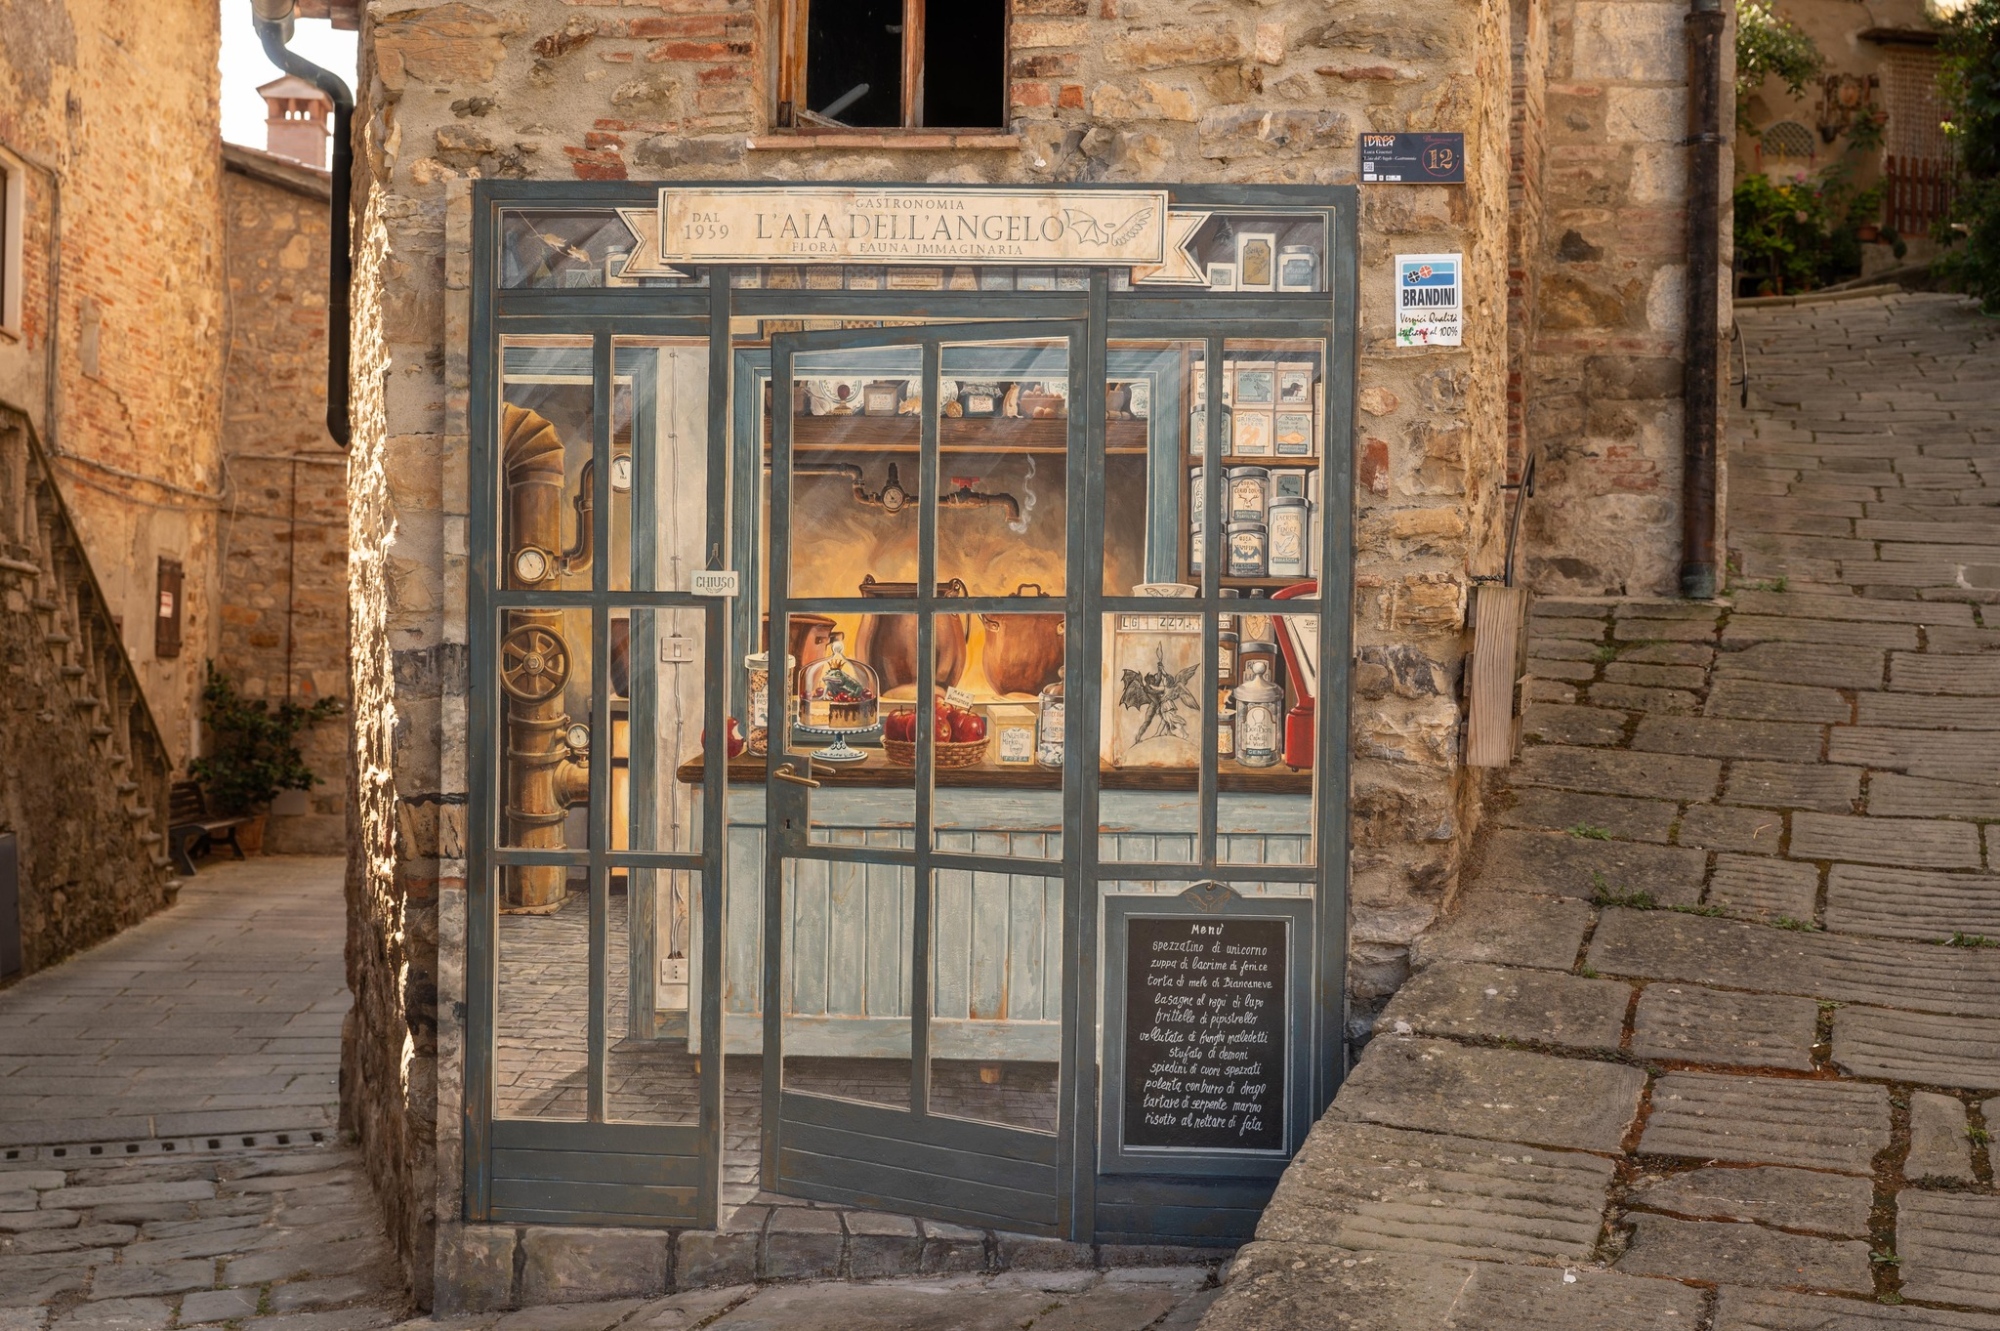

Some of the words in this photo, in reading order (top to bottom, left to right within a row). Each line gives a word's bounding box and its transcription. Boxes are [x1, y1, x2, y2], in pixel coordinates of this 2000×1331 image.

[1428, 148, 1453, 169] 12
[855, 198, 965, 210] GASTRONOMIA
[692, 212, 721, 223] DAL
[684, 224, 730, 240] 1959
[755, 213, 835, 240] L'AIA
[849, 213, 1065, 242] DELL'ANGELO
[791, 241, 838, 253] FLORA
[859, 242, 909, 254] FAUNA
[1402, 287, 1455, 307] BRANDINI
[1400, 312, 1427, 324] Vernici
[1428, 311, 1458, 324] Qualità
[1439, 326, 1459, 337] 100%
[695, 576, 735, 589] CHIUSO
[1191, 923, 1224, 936] Menù
[1152, 939, 1204, 952] spezzatino
[1212, 940, 1221, 953] di
[1226, 945, 1268, 956] unicorno
[1150, 959, 1178, 969] zuppa
[1180, 957, 1189, 970] di
[1192, 956, 1228, 970] lacrime
[1229, 958, 1238, 971] di
[1239, 961, 1268, 976] fenice
[1147, 974, 1174, 987] torta
[1176, 974, 1185, 987] di
[1188, 976, 1208, 988] mele
[1212, 976, 1220, 988] di
[1223, 977, 1273, 989] Biancaneve
[1154, 993, 1194, 1009] lasagne
[1196, 993, 1206, 1006] al
[1232, 995, 1241, 1008] di
[1244, 994, 1265, 1010] lupo
[1154, 1008, 1196, 1024] frittelle
[1199, 1011, 1208, 1024] di
[1209, 1011, 1259, 1029] pipistrello
[1139, 1026, 1184, 1042] vellutata
[1188, 1030, 1196, 1042] di
[1199, 1030, 1226, 1046] funghi
[1226, 1030, 1269, 1045] maledetti
[1168, 1046, 1203, 1064] stufato
[1208, 1046, 1216, 1059] di
[1219, 1046, 1249, 1061] demoni
[1149, 1060, 1188, 1074] spiedini
[1190, 1062, 1198, 1074] di
[1200, 1064, 1221, 1077] cuori
[1223, 1061, 1262, 1077] spezzati
[1143, 1076, 1183, 1093] polenta
[1184, 1082, 1200, 1093] con
[1200, 1079, 1224, 1094] burro
[1226, 1081, 1235, 1095] di
[1240, 1081, 1267, 1100] drago
[1143, 1094, 1180, 1108] tartare
[1181, 1095, 1190, 1108] di
[1190, 1098, 1228, 1113] serpente
[1232, 1101, 1262, 1113] marino
[1144, 1111, 1177, 1125] risotto
[1181, 1112, 1193, 1127] al
[1193, 1114, 1226, 1129] nettare
[1228, 1114, 1237, 1128] di
[1239, 1114, 1264, 1136] fata
